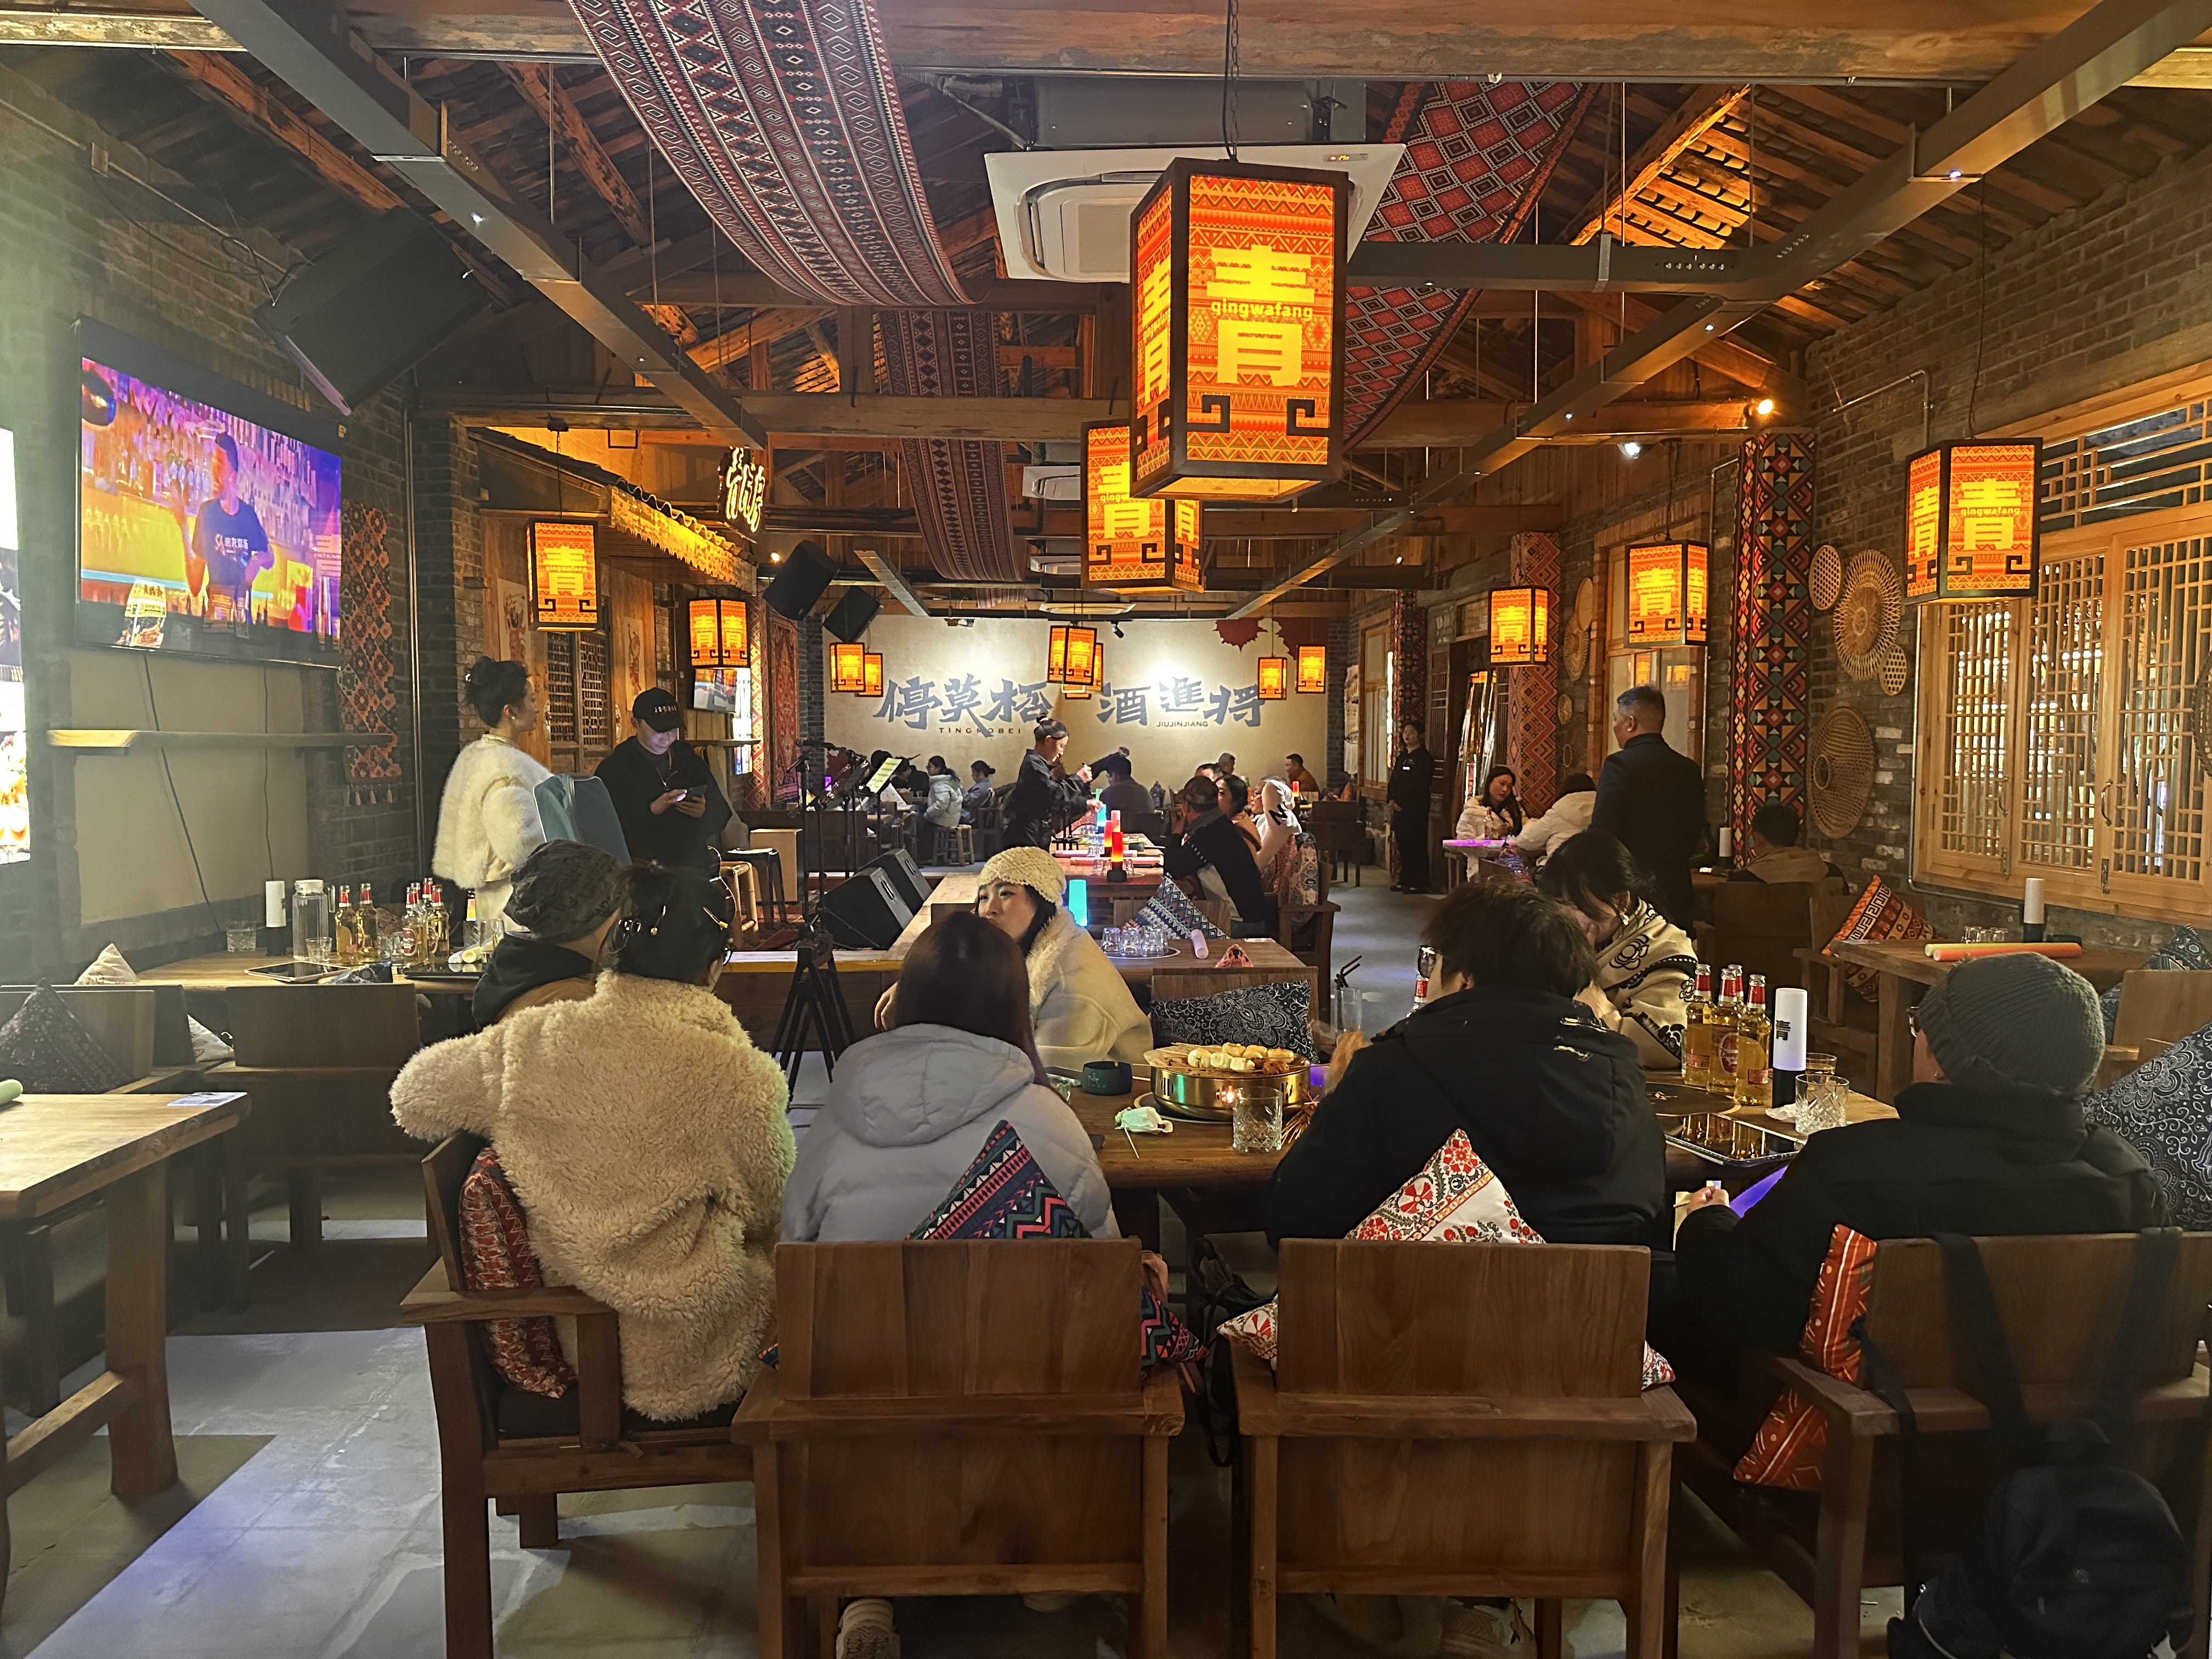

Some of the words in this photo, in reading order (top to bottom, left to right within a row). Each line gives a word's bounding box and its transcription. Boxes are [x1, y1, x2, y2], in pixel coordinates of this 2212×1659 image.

[1206, 245, 1314, 387] 青
[1211, 300, 1313, 321] qingwafang
[1913, 486, 1939, 558] 青
[1959, 478, 2021, 550] 青
[1961, 506, 2021, 516] qingwafang
[543, 546, 587, 596] 青
[1636, 568, 1675, 616] 青
[693, 614, 715, 648] 青
[724, 616, 743, 648] 青
[1497, 606, 1526, 642] 青
[1070, 640, 1090, 668] 青
